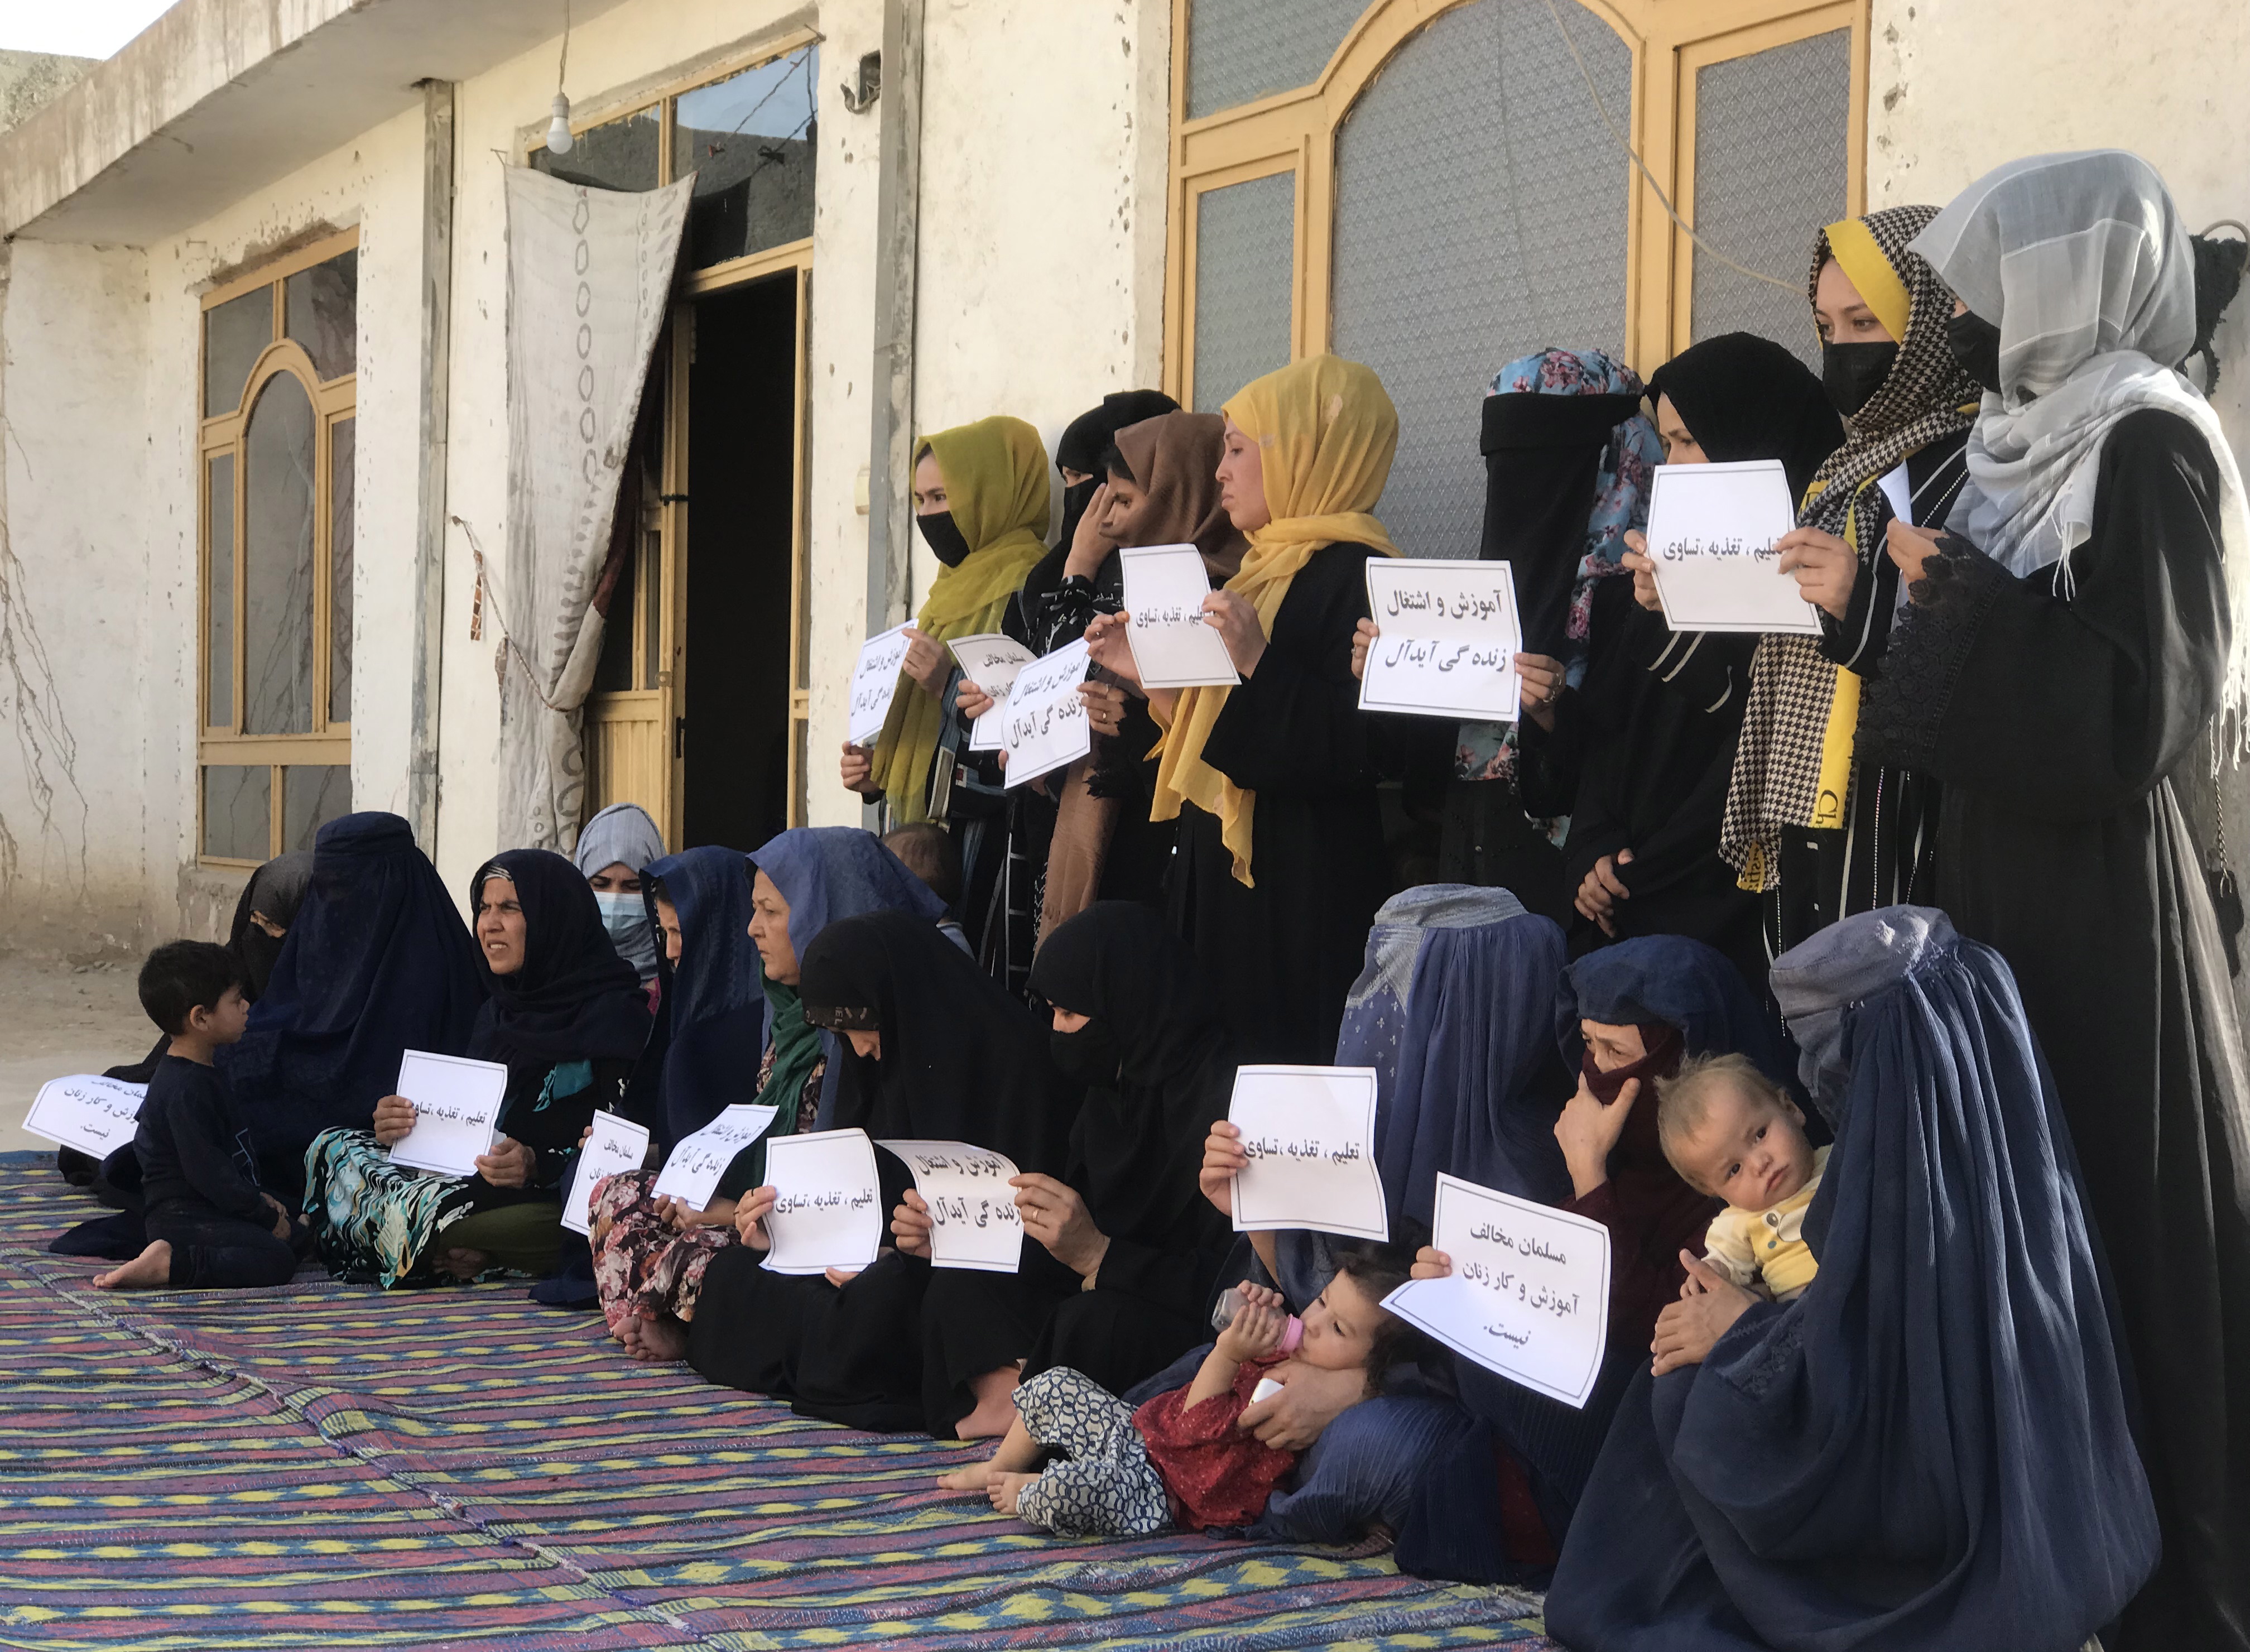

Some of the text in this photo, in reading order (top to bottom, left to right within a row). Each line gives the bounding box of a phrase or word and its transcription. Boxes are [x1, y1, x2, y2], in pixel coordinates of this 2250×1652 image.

[1709, 537, 1742, 561] تغذیه
[1162, 607, 1181, 627] تغذیه
[1387, 589, 1502, 621] آموزش و اشتغال
[1439, 645, 1470, 672] گی
[1472, 648, 1506, 673] زنده
[1013, 675, 1047, 706] اشتغال
[1043, 676, 1052, 692] و
[1041, 704, 1053, 736] گی
[1816, 789, 1838, 826] Ch
[64, 1089, 87, 1101] زنان
[103, 1104, 112, 1112] و
[436, 1106, 460, 1121] تغذیه
[466, 1111, 487, 1126] تعلیم
[1288, 1139, 1320, 1161] تغذیه
[1332, 1141, 1359, 1166] تعلیم
[691, 1153, 711, 1174] گی
[706, 1157, 725, 1176] زنده
[915, 1154, 1005, 1178] آموزش و اشتغال
[814, 1192, 842, 1211] تغذیه
[851, 1188, 872, 1211] تعلیم
[975, 1200, 989, 1228] گی
[1470, 1222, 1566, 1265] مسلمان مخالف
[1463, 1262, 1580, 1317] آموزش و کار زنان
